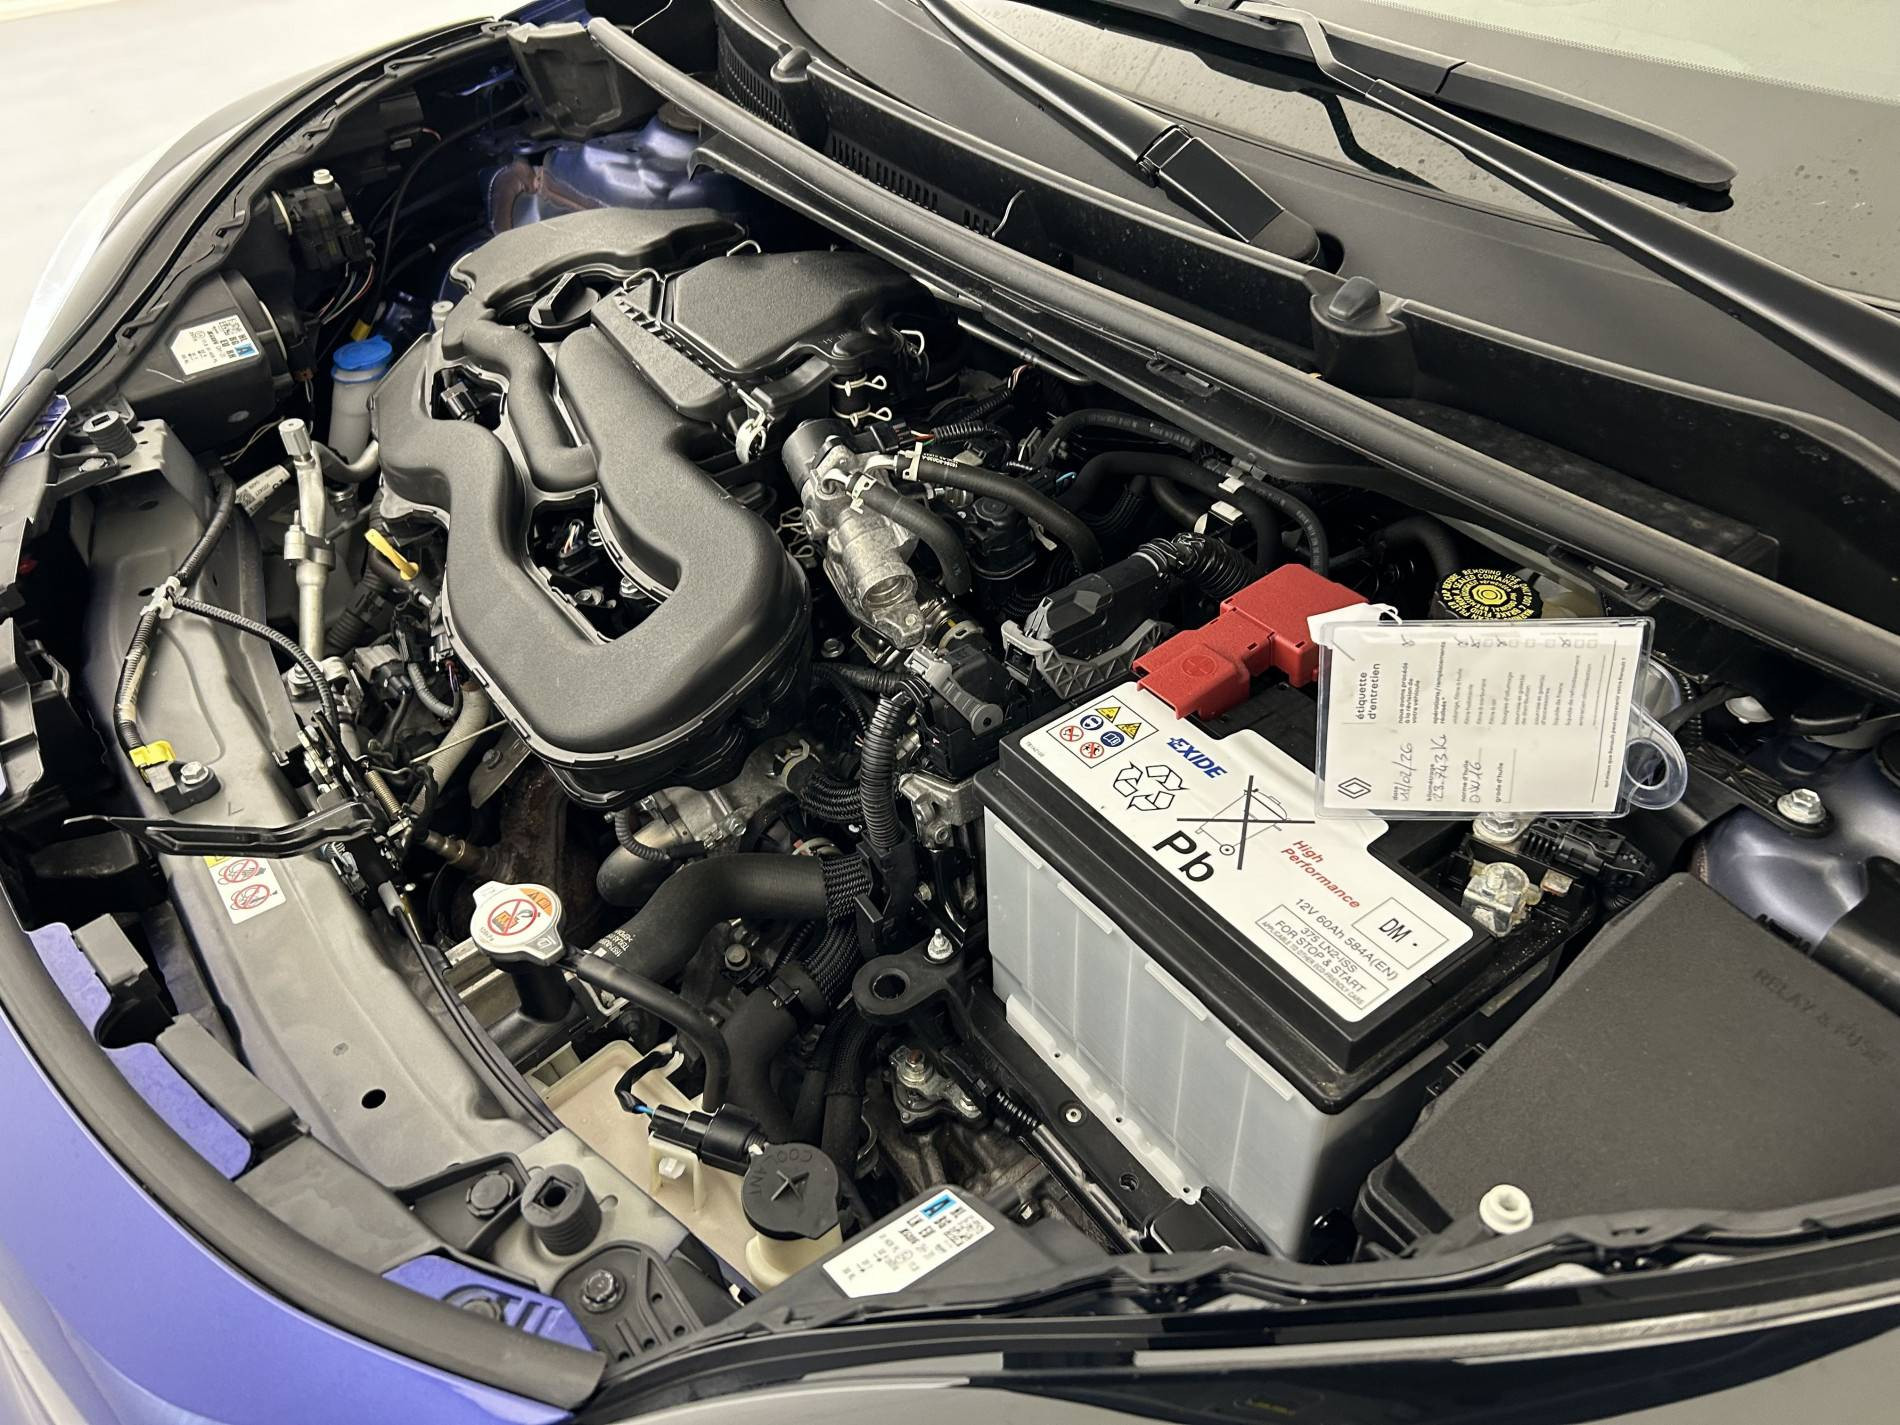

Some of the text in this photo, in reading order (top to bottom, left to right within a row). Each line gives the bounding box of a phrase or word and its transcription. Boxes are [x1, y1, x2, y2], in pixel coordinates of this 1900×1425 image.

[235, 344, 255, 356] A
[1452, 574, 1477, 588] SEALED
[1461, 568, 1502, 576] REMOVING
[1477, 573, 1520, 589] CONTAINER
[1505, 574, 1522, 583] USE
[1470, 607, 1493, 617] FLUID
[1400, 662, 1408, 688] procédé
[1407, 678, 1413, 686] de
[1355, 672, 1367, 720] étiquette
[1367, 663, 1381, 720] d'entretien
[1167, 737, 1228, 780] EXIDE
[1425, 764, 1436, 802] kilométrage
[1496, 763, 1504, 784] d'huile
[1152, 830, 1216, 883] Pb
[1291, 839, 1324, 863] High
[1280, 847, 1361, 909] Performance
[1294, 897, 1399, 981] 12V 60Ah 584A(EN)
[1378, 916, 1412, 943] DM
[1274, 919, 1298, 939] FOR
[1295, 936, 1325, 959] STOP
[1330, 964, 1366, 993] START
[1299, 926, 1358, 972] 375 LN2-ISS
[1752, 967, 1816, 1016] RELAY
[921, 1196, 953, 1218] A
